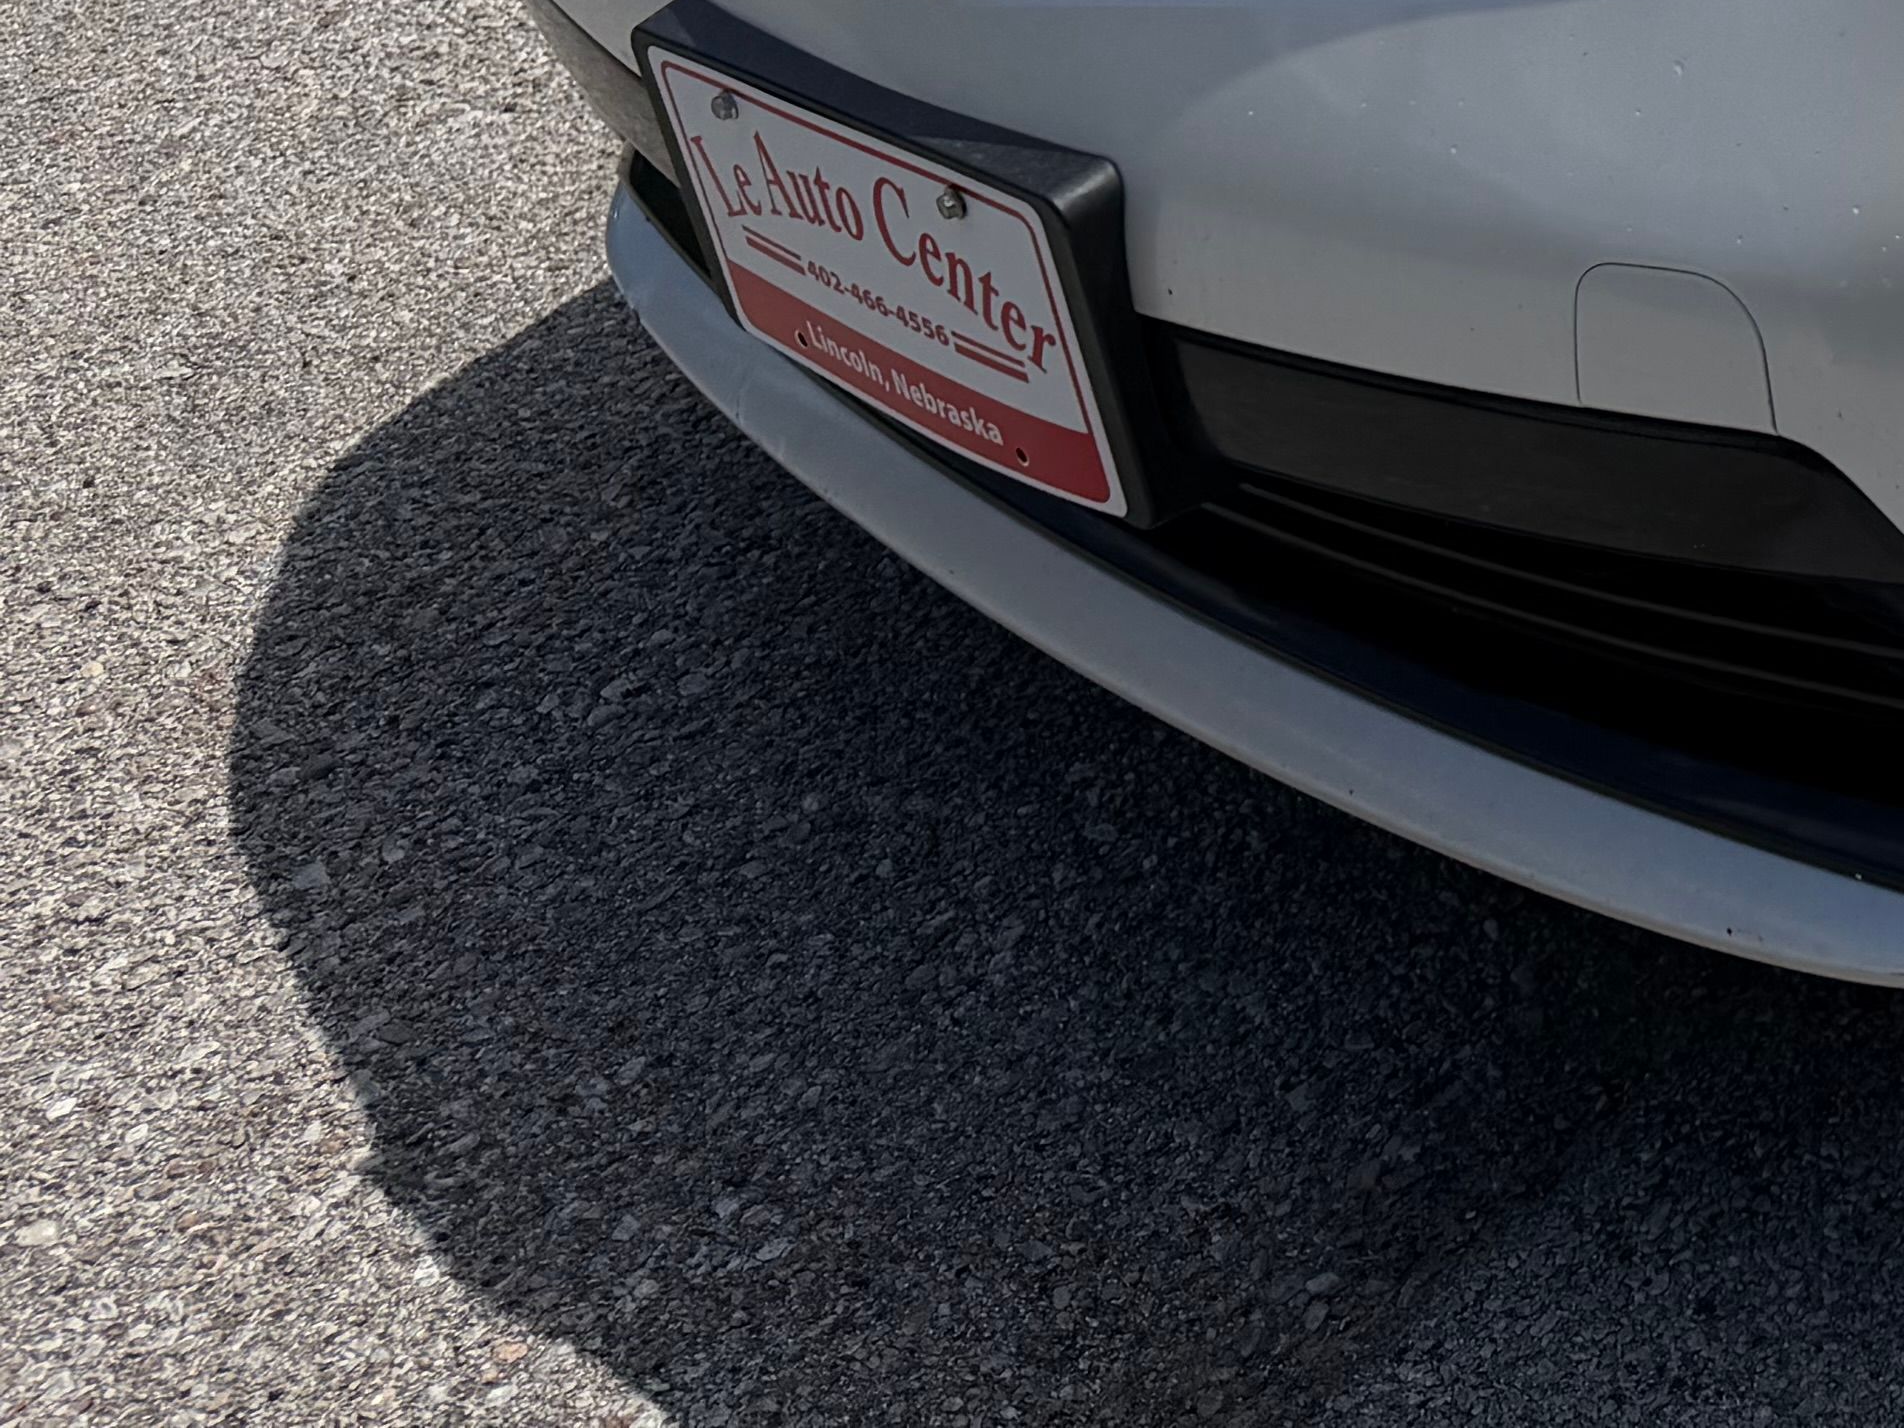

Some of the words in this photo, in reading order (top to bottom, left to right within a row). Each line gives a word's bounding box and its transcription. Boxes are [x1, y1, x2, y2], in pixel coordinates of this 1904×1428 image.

[690, 135, 763, 218] Le
[754, 130, 865, 242] Auto
[873, 177, 1057, 374] Center
[806, 259, 951, 347] 402-466-4556
[806, 320, 891, 393] Lincoln,
[891, 367, 1004, 448] Nebraska
